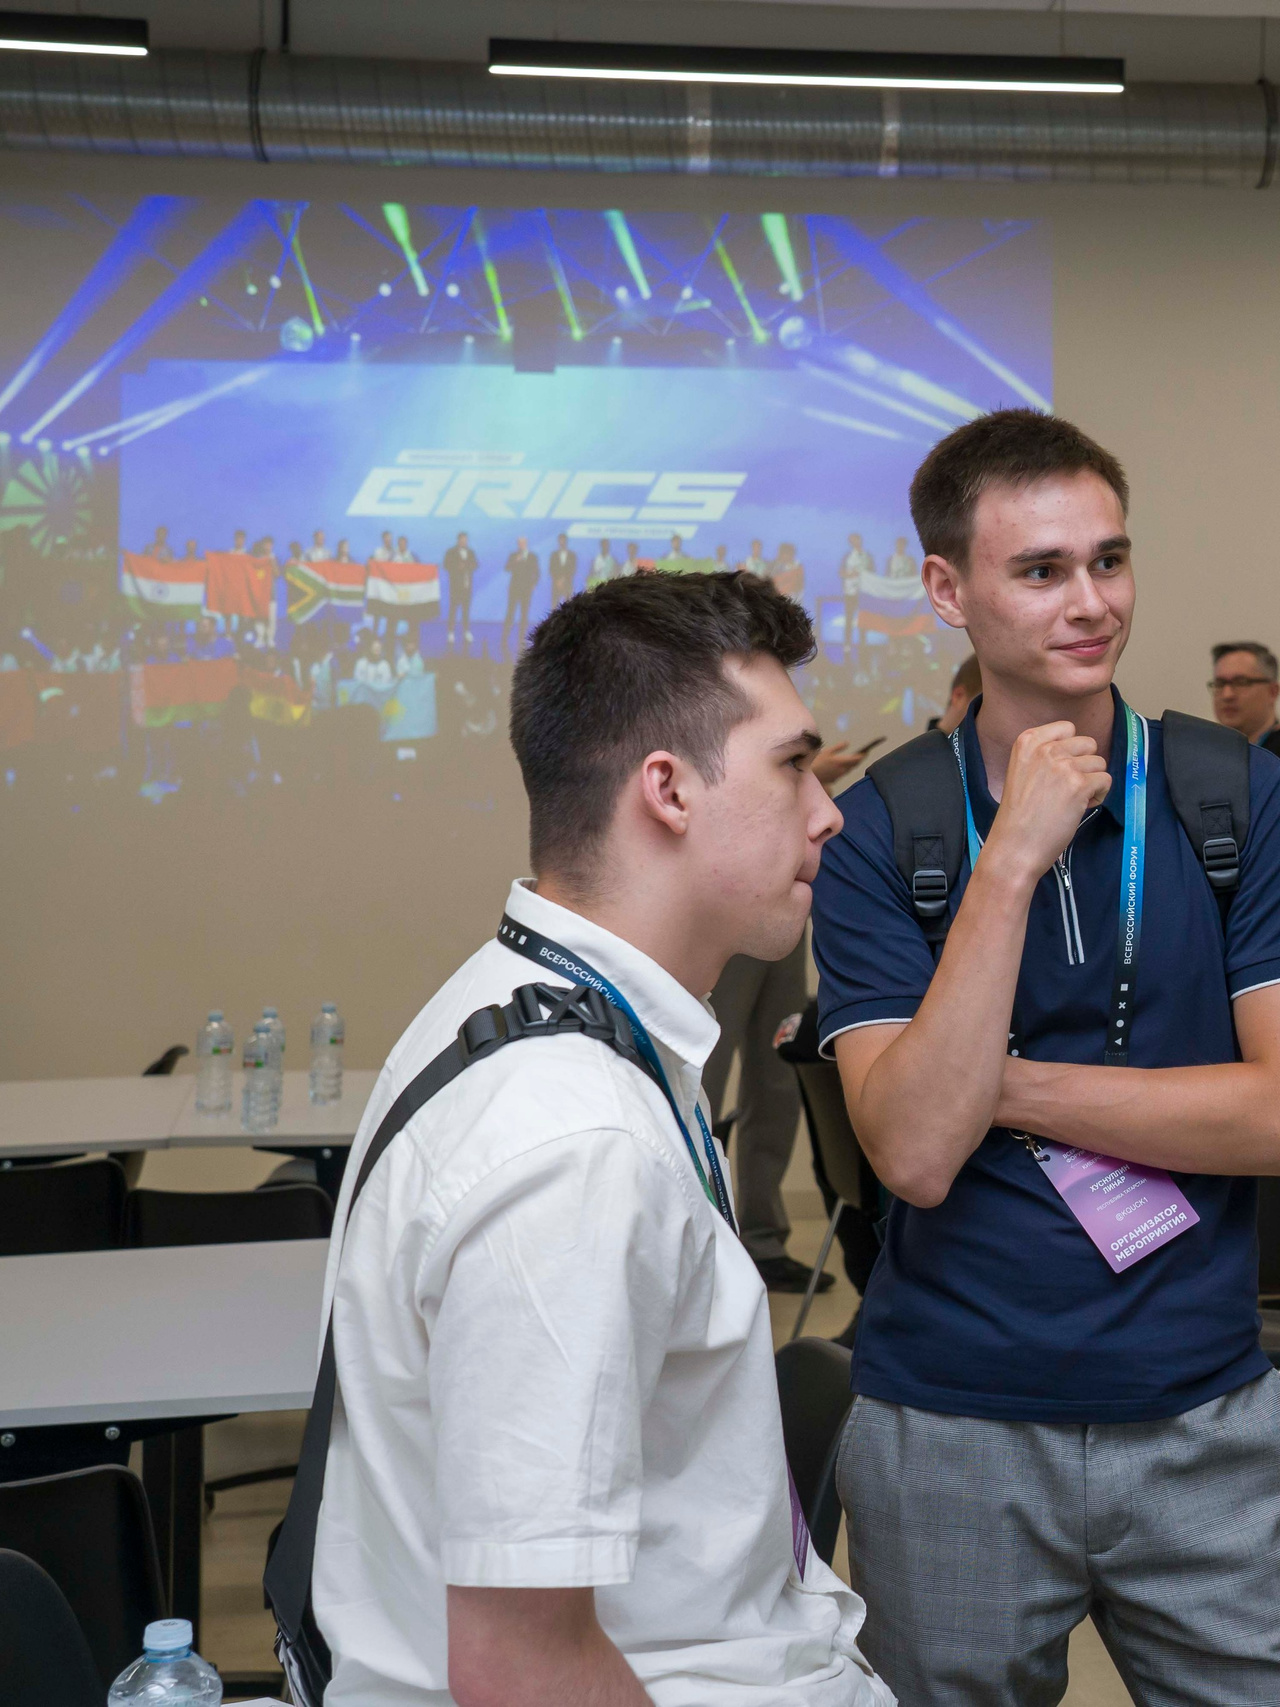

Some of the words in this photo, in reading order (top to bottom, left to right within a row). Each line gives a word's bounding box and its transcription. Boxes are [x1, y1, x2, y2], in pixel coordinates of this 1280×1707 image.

[346, 467, 747, 522] BRICS
[1131, 747, 1139, 780] ЛИДЕРЫ
[1129, 846, 1139, 880] ФОРУМ
[1123, 882, 1137, 965] ВСЕРОССИЙСКИЙ
[1089, 1164, 1131, 1193] ХУСНУЛЛИН
[1102, 1175, 1126, 1194] ЛИНАР
[1110, 1204, 1178, 1251] ОРГАНИЗАТОР
[1115, 1212, 1188, 1262] МЕРОПРИЯТИЯ
